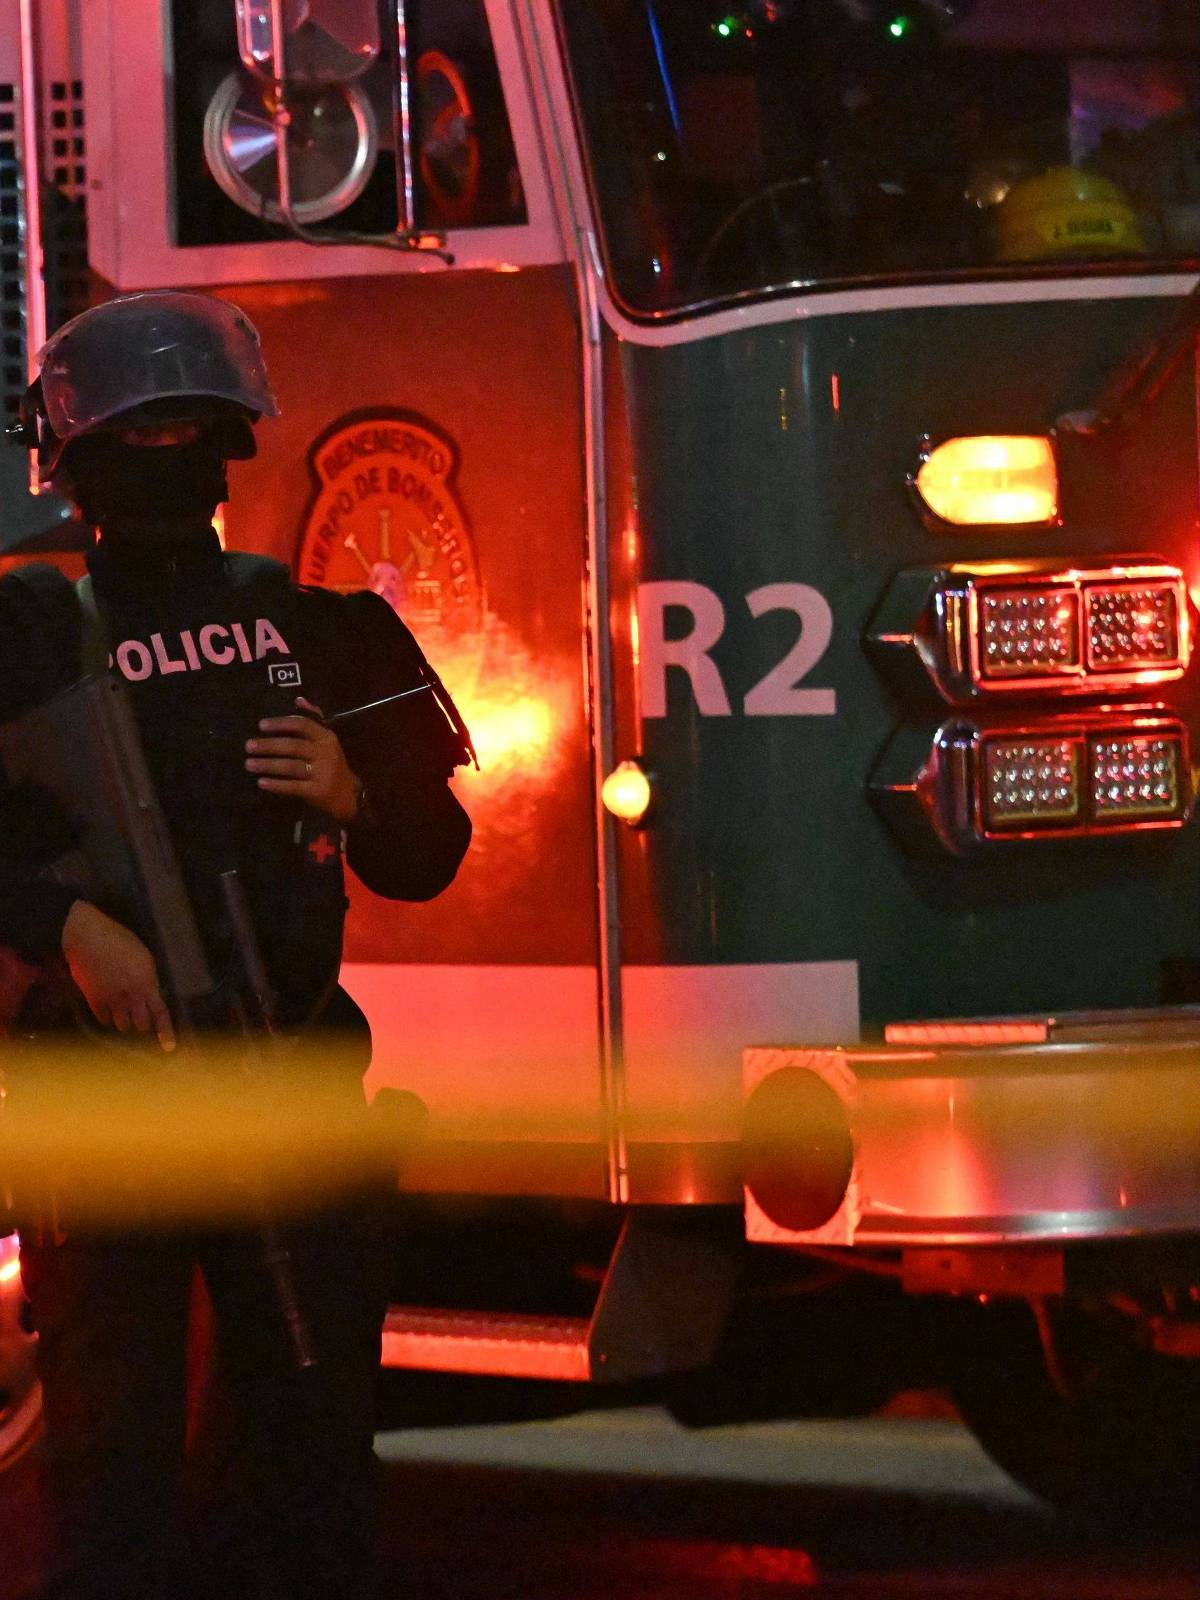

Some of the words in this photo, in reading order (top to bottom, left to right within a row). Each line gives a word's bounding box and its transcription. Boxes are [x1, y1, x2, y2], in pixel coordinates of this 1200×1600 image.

[307, 490, 354, 582] UERPO
[354, 466, 383, 500] DE
[108, 618, 290, 682] OLICIA
[641, 580, 836, 718] R2
